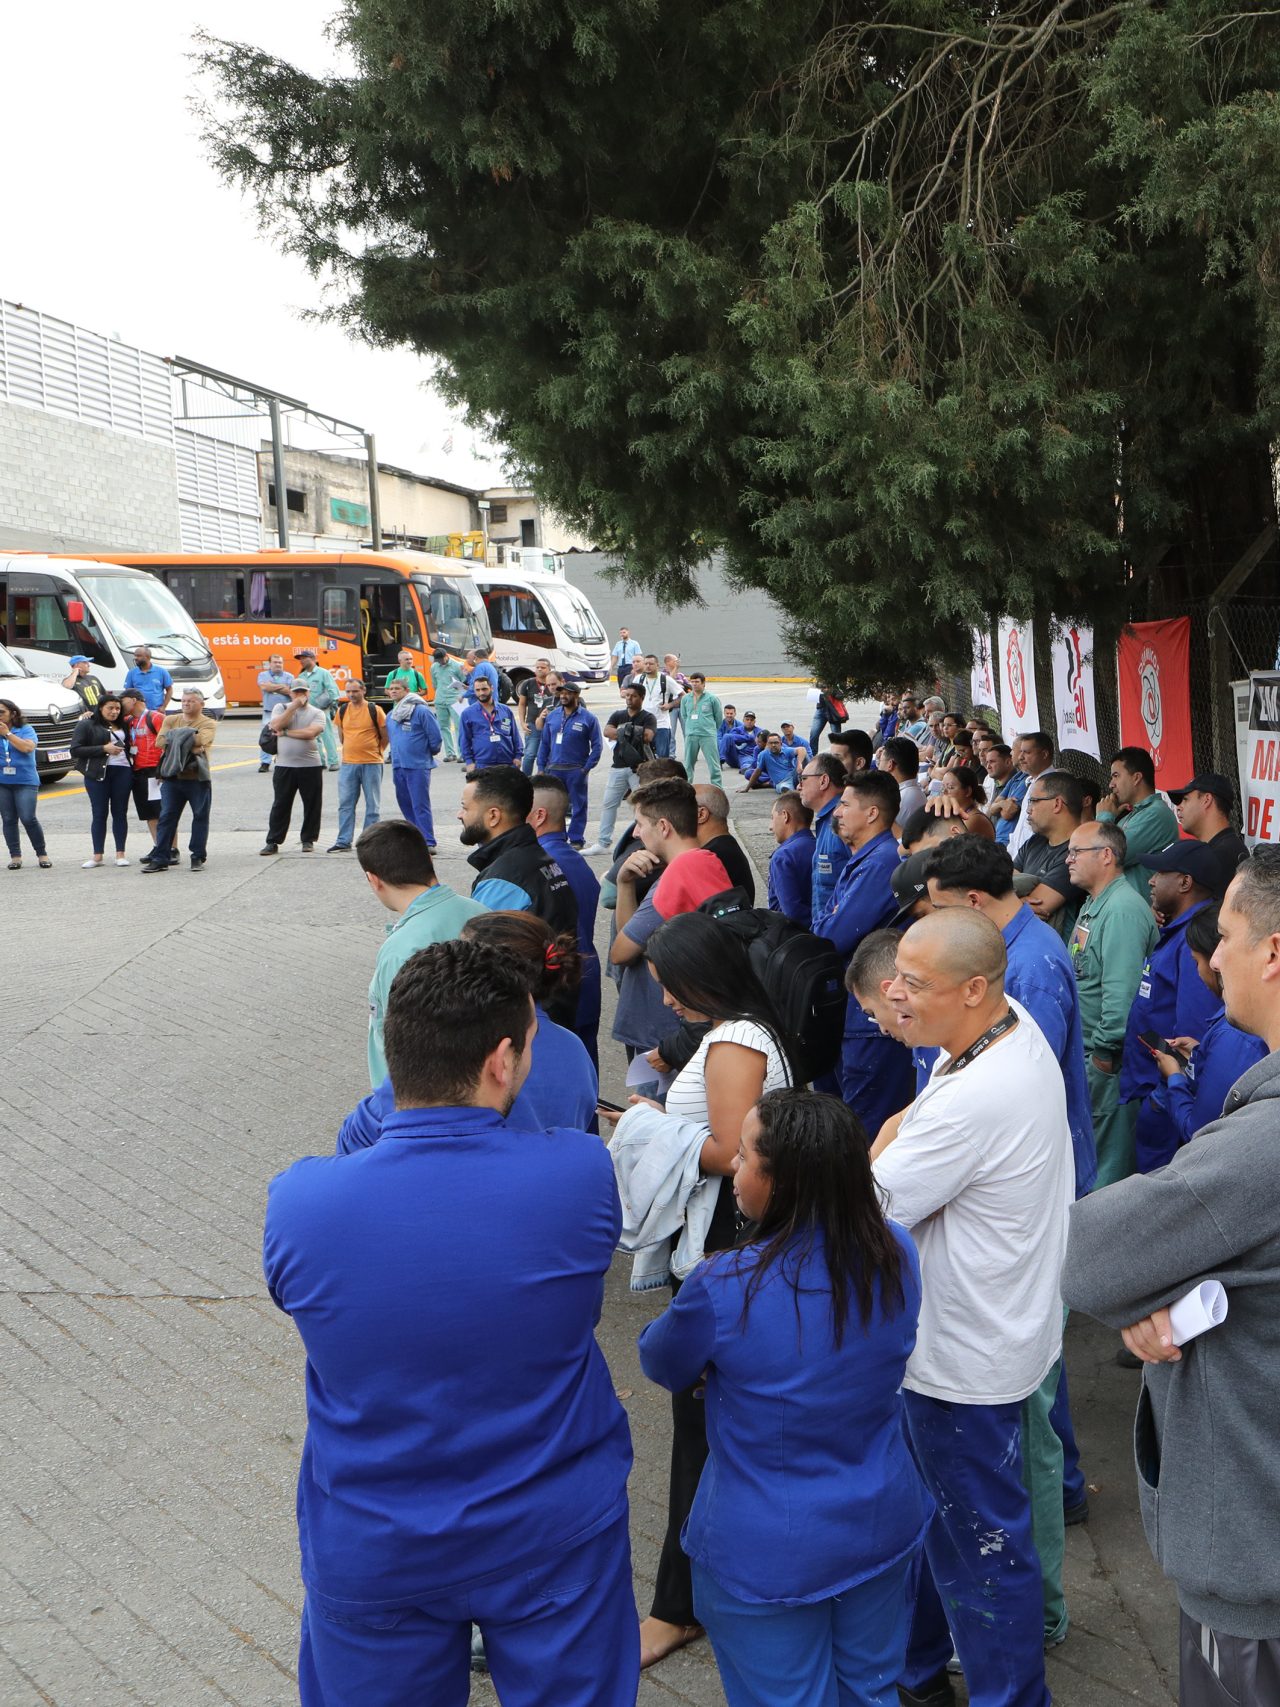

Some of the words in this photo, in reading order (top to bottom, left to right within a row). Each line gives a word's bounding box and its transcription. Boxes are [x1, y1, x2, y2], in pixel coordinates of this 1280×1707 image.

[212, 634, 240, 645] está
[243, 636, 250, 645] a
[253, 634, 292, 645] bordo
[1247, 796, 1274, 840] DE
